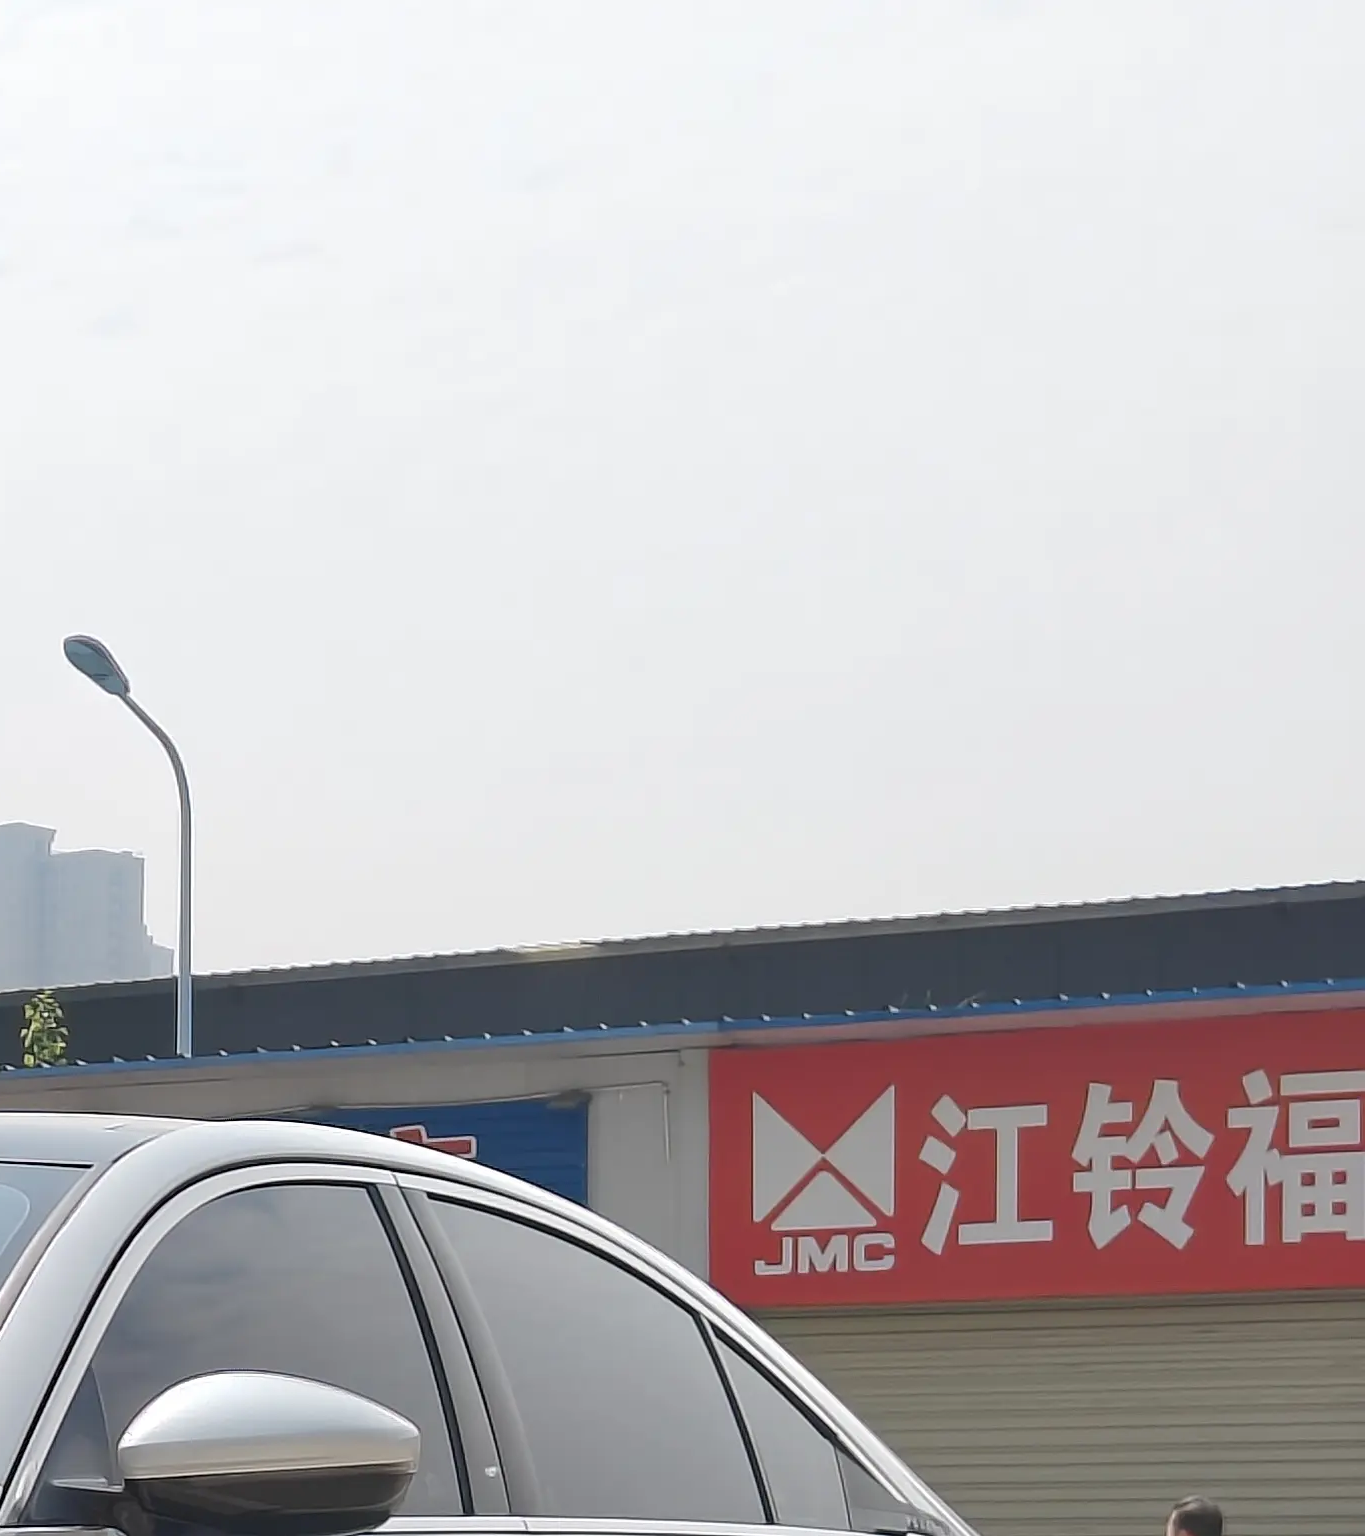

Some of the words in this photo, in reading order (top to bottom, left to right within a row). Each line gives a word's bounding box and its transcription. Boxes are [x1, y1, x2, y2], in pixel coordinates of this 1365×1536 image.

[918, 1068, 1365, 1255] 江铃福
[754, 1232, 896, 1276] JMC
